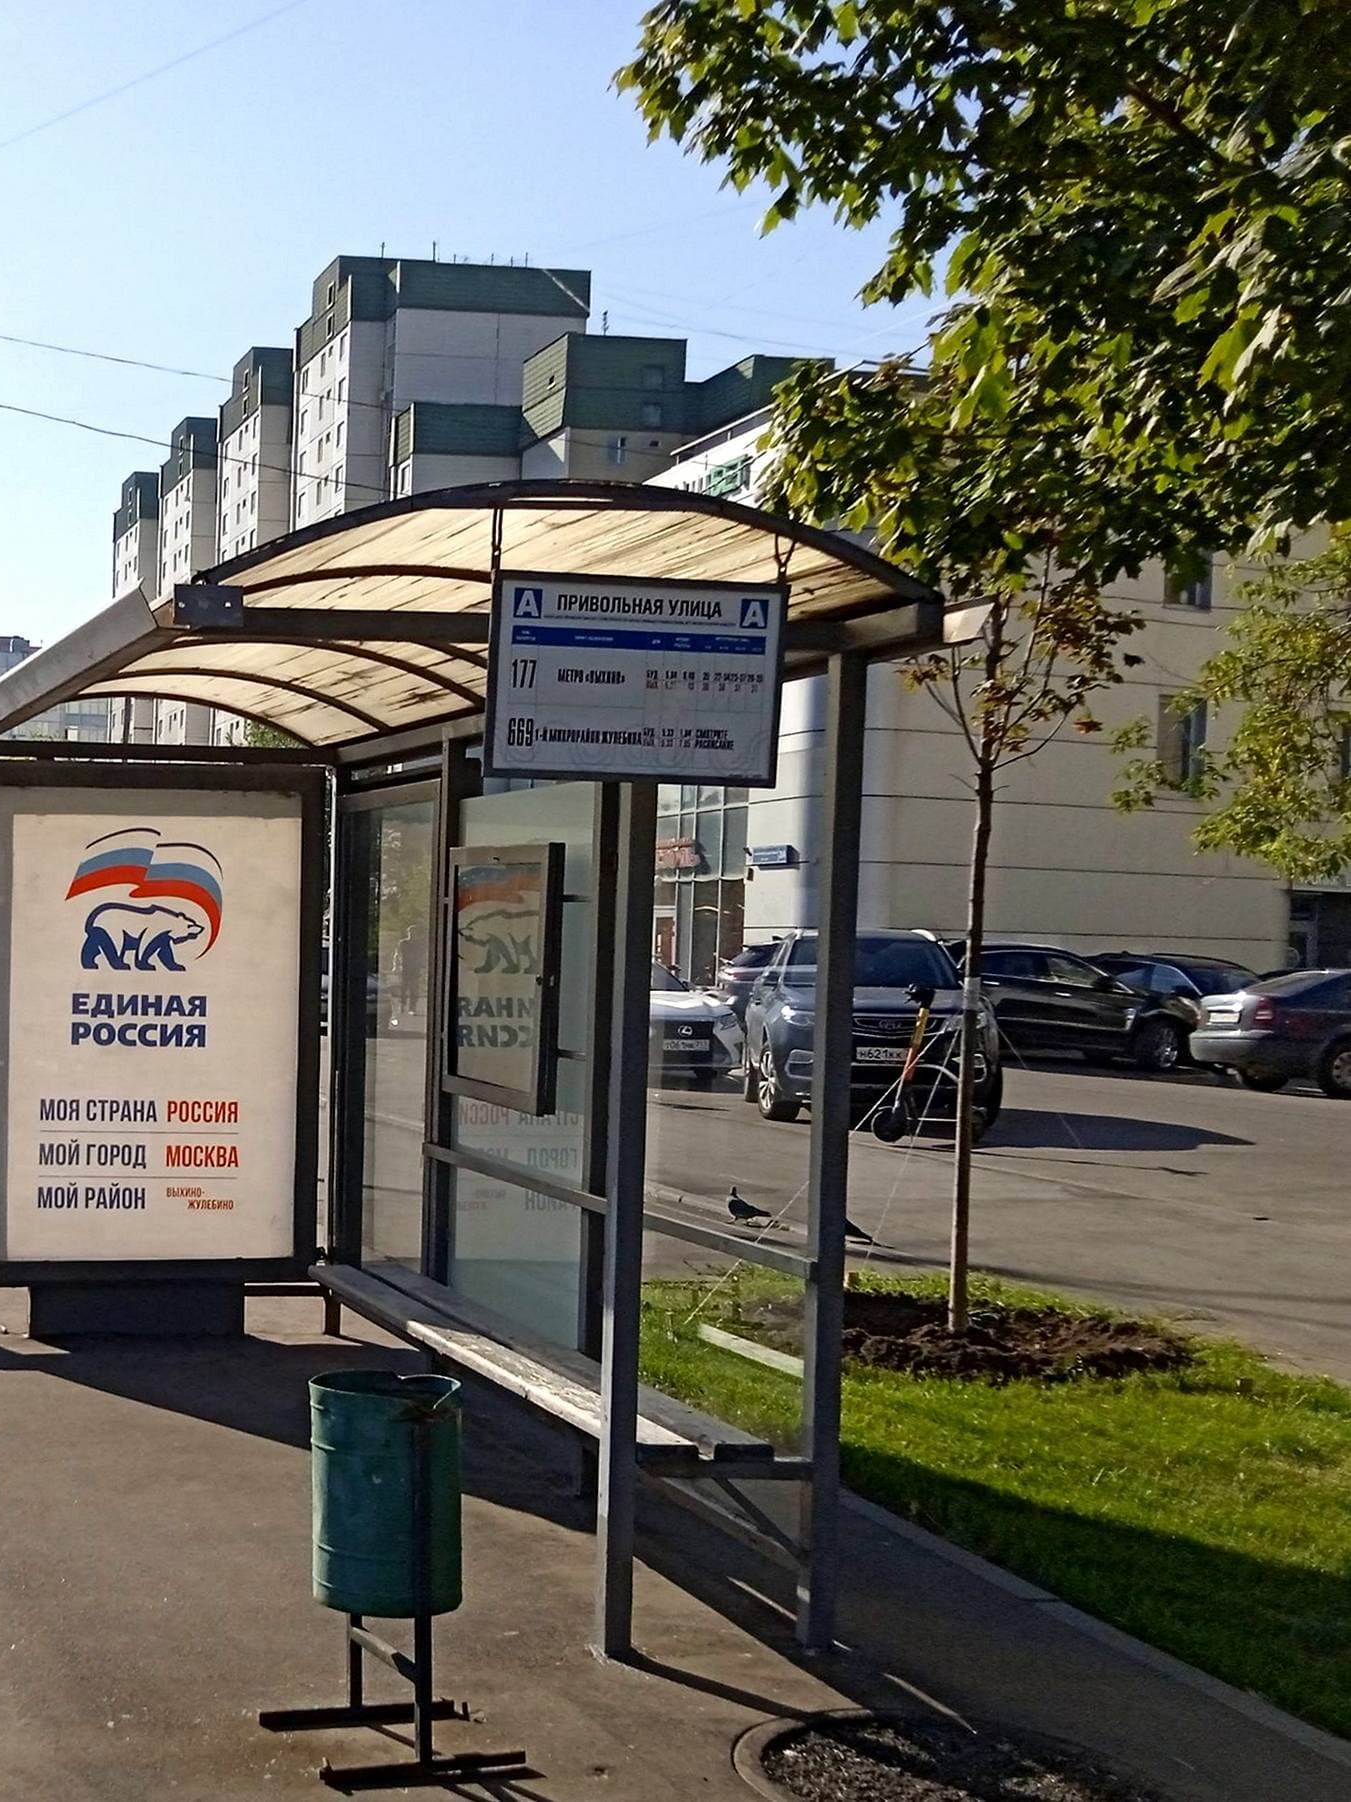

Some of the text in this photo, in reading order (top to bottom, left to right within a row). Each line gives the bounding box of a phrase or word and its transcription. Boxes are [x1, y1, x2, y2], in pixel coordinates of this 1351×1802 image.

[557, 594, 722, 620] ПРИВОЛЬНАЯ УЛИЦА
[512, 659, 537, 688] 177
[557, 668, 584, 683] МЕТРО
[507, 717, 534, 747] 669
[71, 992, 207, 1018] ЕДИНАЯ
[70, 1022, 206, 1047] РОССИЯ
[40, 1099, 238, 1123] МОЯ СТРАНА РОССИЯ
[39, 1139, 239, 1169] МОЙ ГОРОД МОСКВА
[37, 1182, 205, 1210] МОЙ РАЙОН ВЫХИНО-
[187, 1199, 234, 1210] ЖУЛЕБИНО
